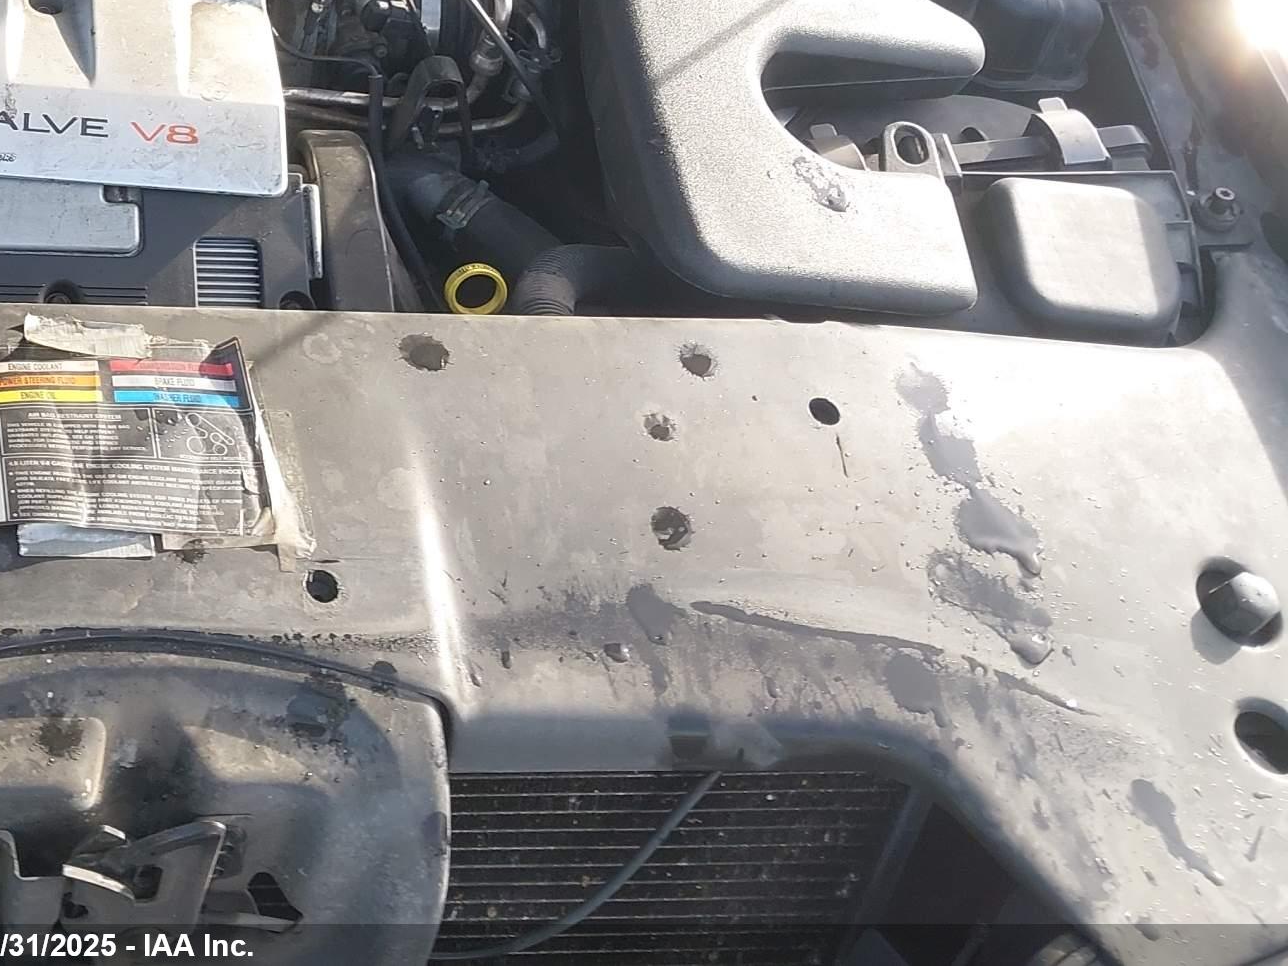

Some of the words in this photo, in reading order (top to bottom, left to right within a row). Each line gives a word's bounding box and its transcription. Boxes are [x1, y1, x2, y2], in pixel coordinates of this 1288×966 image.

[131, 121, 199, 144] V8
[8, 363, 32, 371] ENGINE
[33, 363, 62, 371] COOLANT
[24, 376, 56, 385] STEERING
[57, 376, 76, 385] FLUID
[154, 378, 175, 386] BRAKE
[177, 378, 195, 386] FLUID
[20, 391, 44, 400] ENGINE
[46, 391, 56, 400] OIL
[154, 393, 182, 402] WASHER
[183, 394, 201, 403] FLUID
